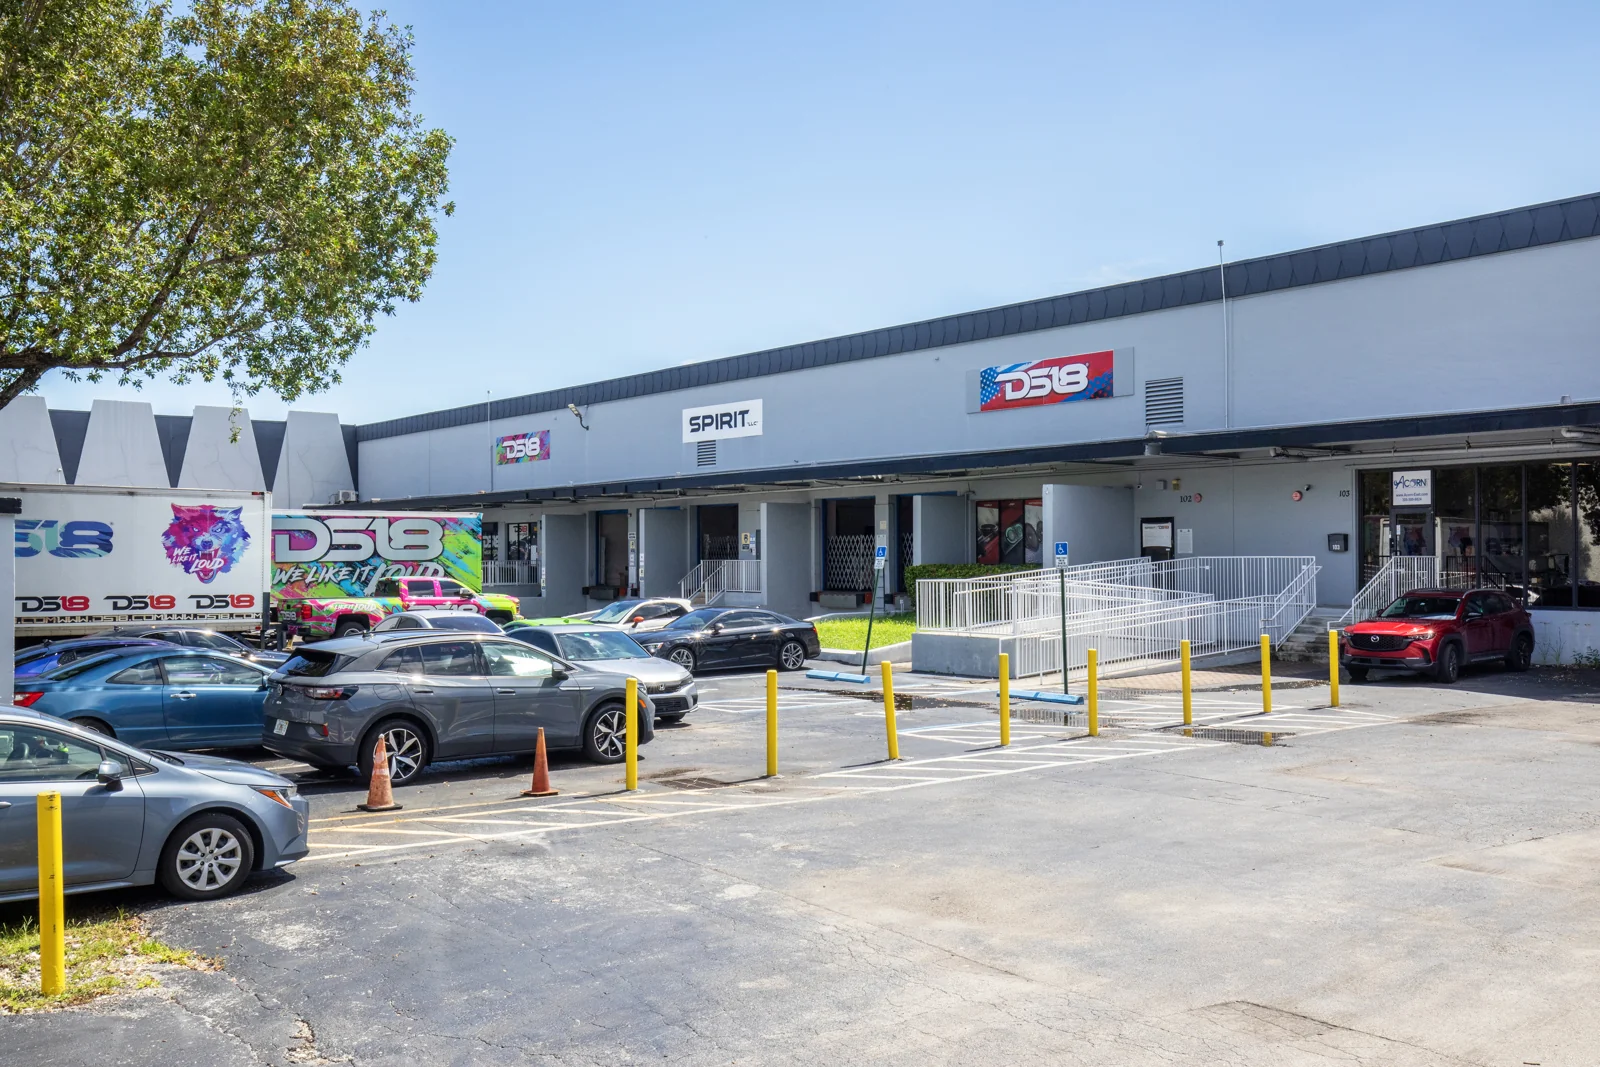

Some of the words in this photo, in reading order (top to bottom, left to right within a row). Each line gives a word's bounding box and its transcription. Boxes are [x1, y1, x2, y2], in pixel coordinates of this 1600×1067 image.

[994, 363, 1088, 401] DS18
[689, 409, 750, 433] SPIRIT
[502, 437, 541, 459] DS18
[1180, 495, 1193, 503] 102
[1339, 490, 1350, 498] 103
[271, 518, 444, 563] DS18
[172, 555, 190, 563] LIKE
[189, 553, 199, 561] IT
[173, 546, 192, 557] WE
[189, 558, 225, 573] LOUD
[272, 566, 305, 585] WE
[304, 566, 353, 584] LIKE
[351, 565, 376, 585] IT
[15, 596, 90, 612] DS18
[103, 595, 176, 611] DS18
[188, 594, 255, 610] DS18
